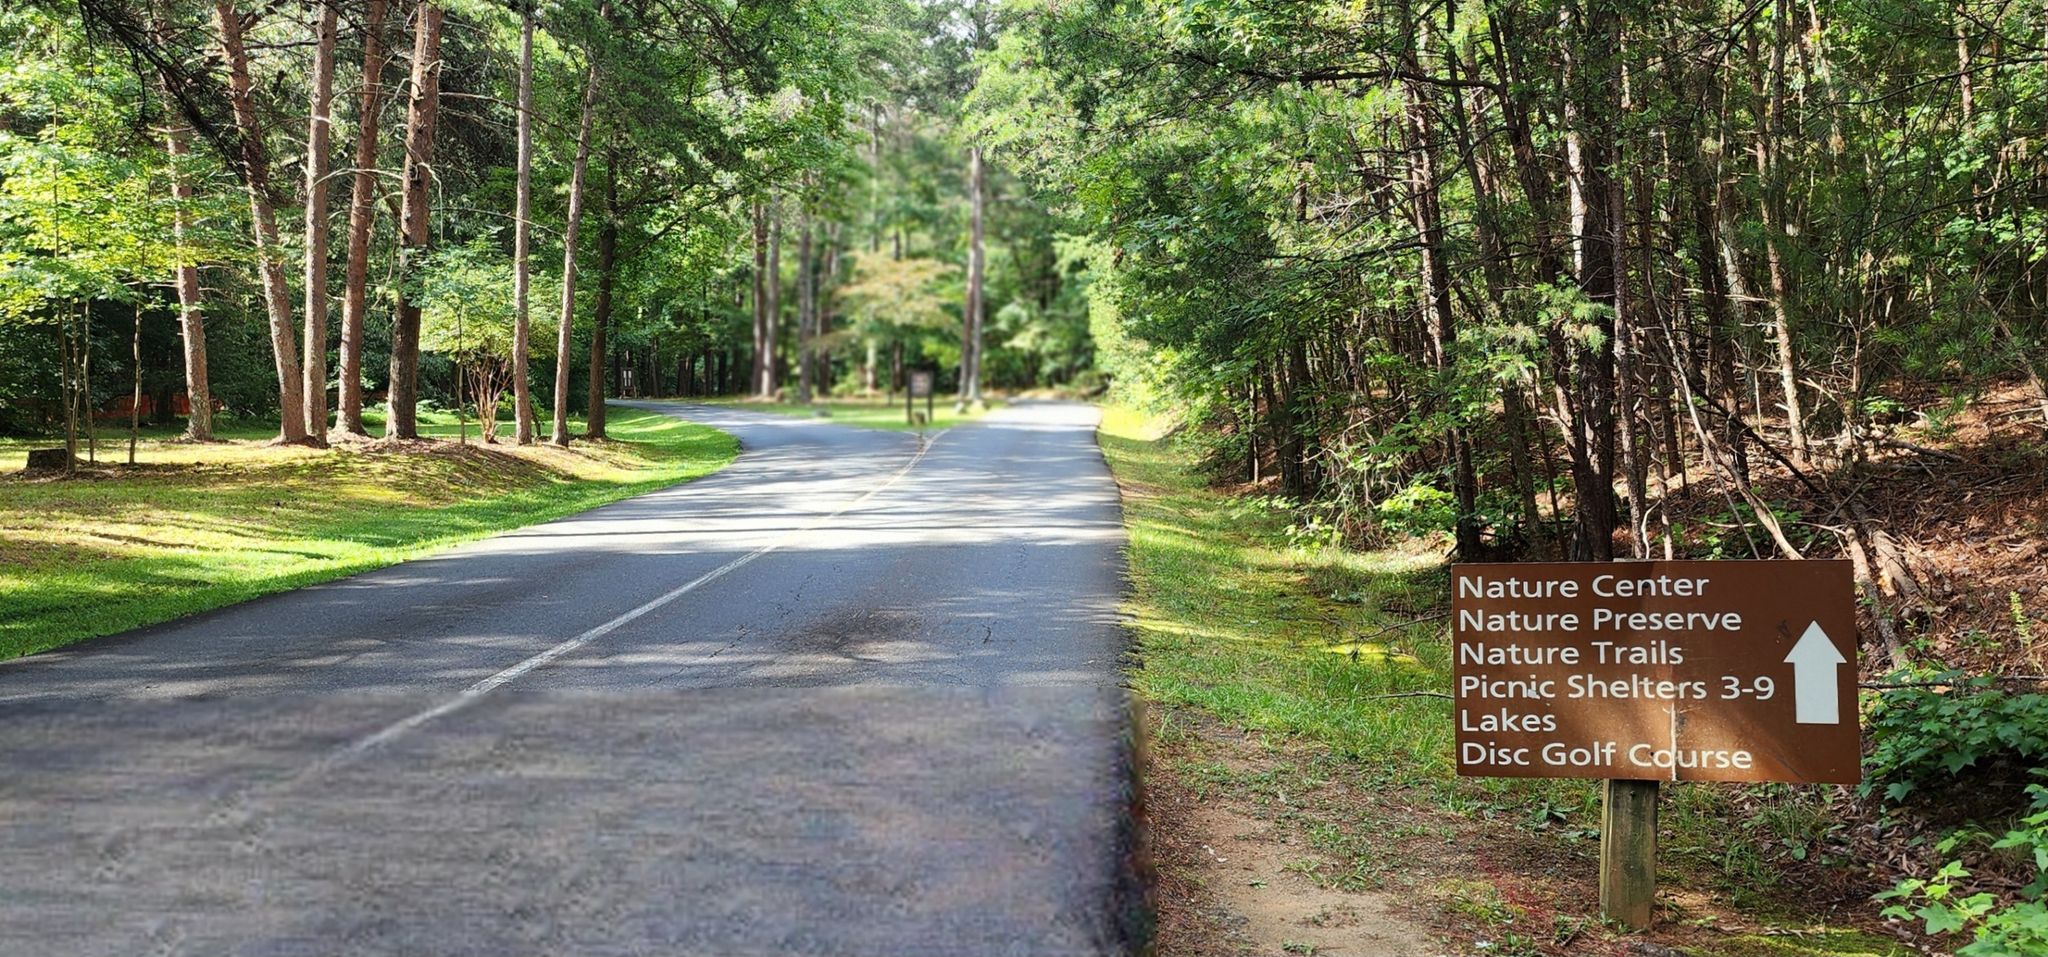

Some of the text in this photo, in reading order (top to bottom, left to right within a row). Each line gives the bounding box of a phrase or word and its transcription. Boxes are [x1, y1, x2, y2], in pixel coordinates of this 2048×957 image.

[1459, 575, 1710, 598] Nature Center
[1459, 608, 1742, 632] Nature Preserve
[1460, 640, 1683, 665] Nature Trails
[1461, 674, 1775, 700] Picnic Shelters 3-9
[1461, 708, 1556, 732] Lakes
[1462, 741, 1752, 768] Disc Golf Course
